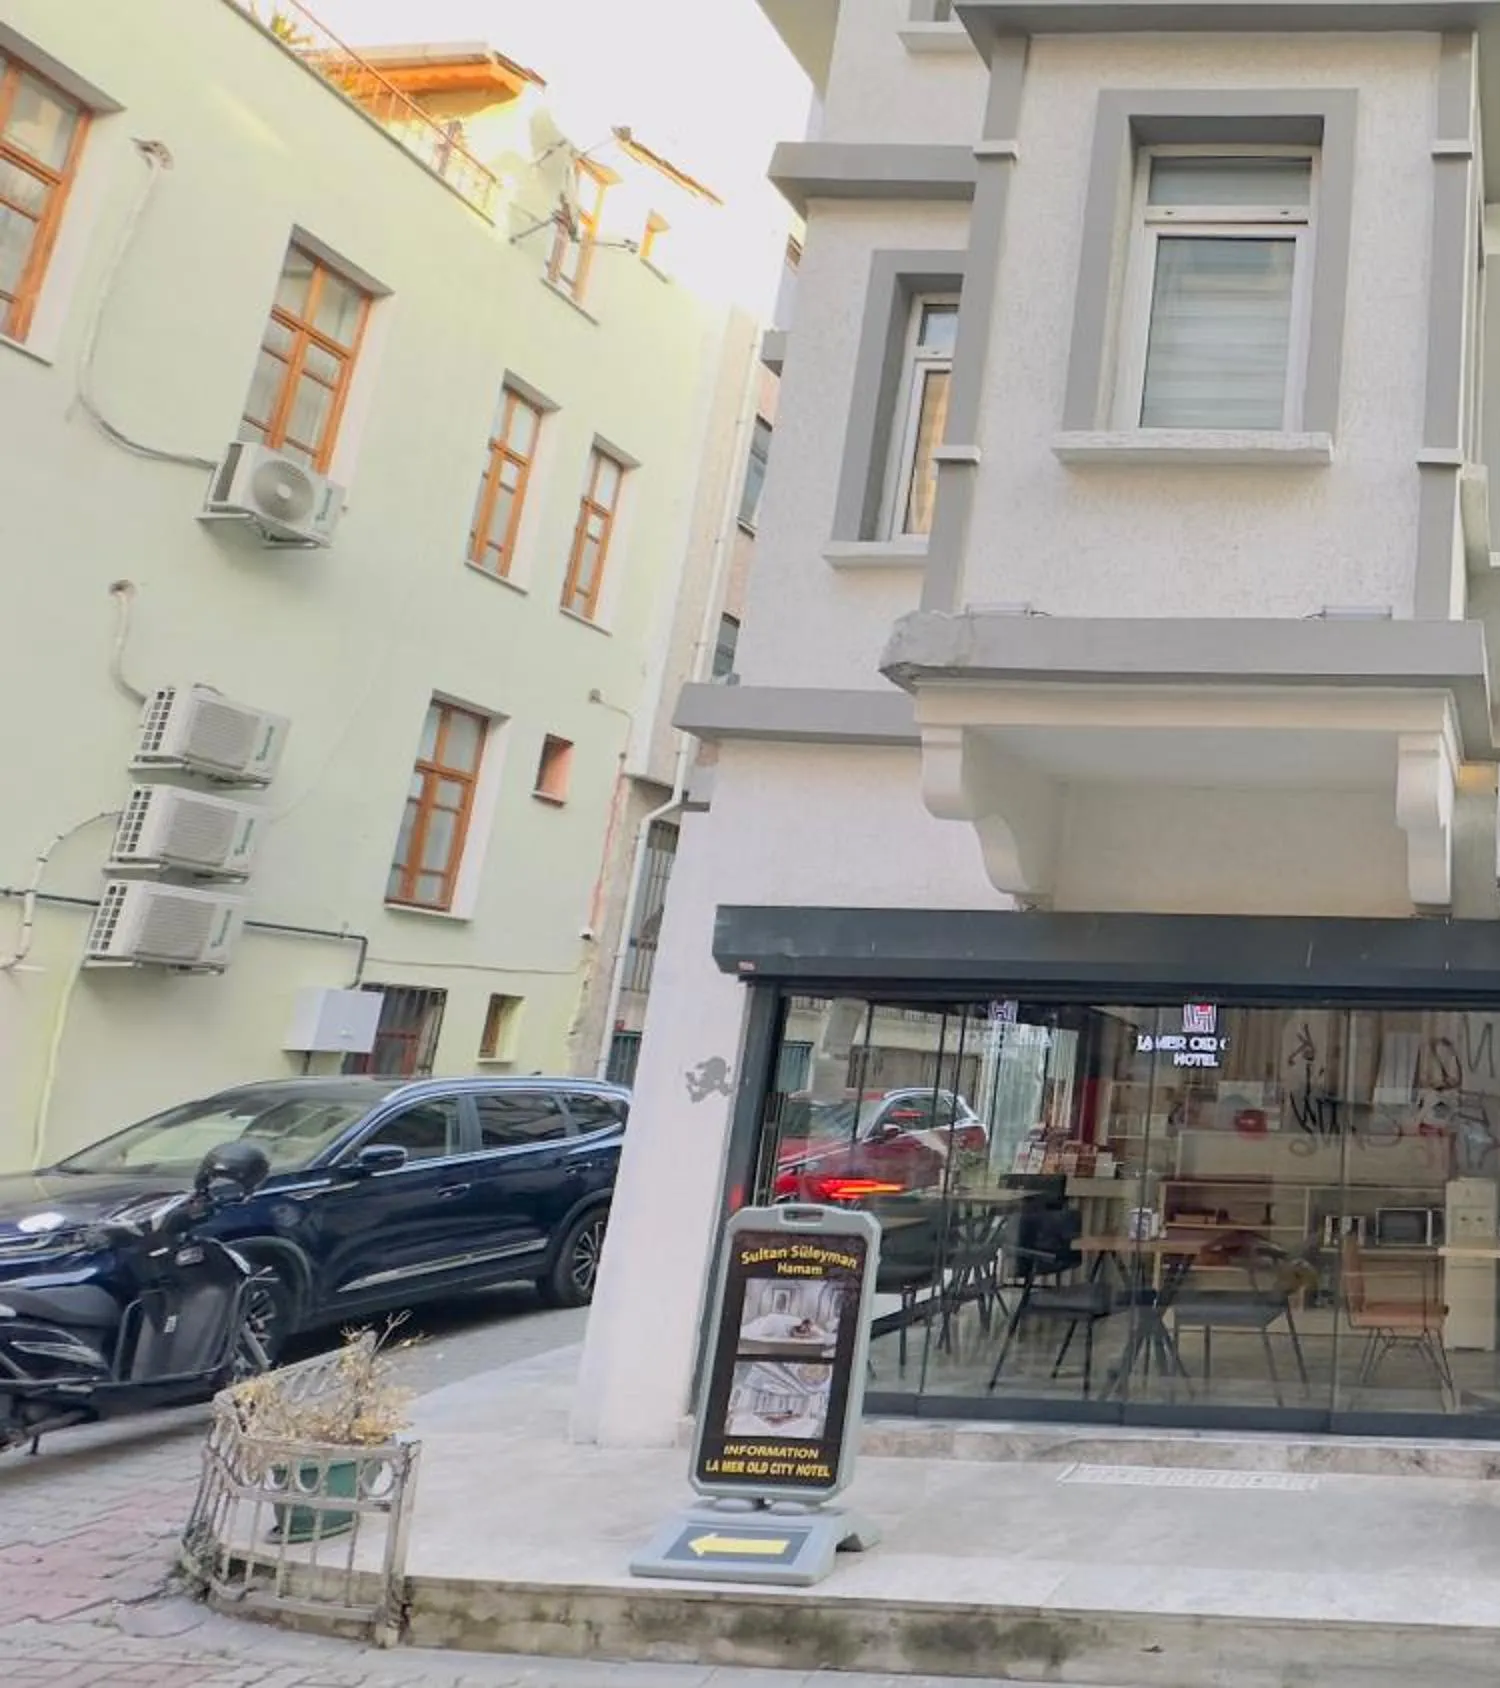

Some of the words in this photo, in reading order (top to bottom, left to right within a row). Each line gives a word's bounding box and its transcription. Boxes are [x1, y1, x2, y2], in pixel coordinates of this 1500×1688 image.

[1173, 1052, 1219, 1067] HOTEL
[741, 1247, 788, 1265] Sultan
[791, 1245, 857, 1269] Süleyman
[777, 1262, 823, 1275] Hamam
[724, 1445, 819, 1459] INFORMATION
[705, 1459, 719, 1472] LA
[722, 1460, 745, 1473] MER
[746, 1461, 769, 1474] OLD
[770, 1462, 796, 1475] CITY
[796, 1463, 830, 1478] HOTEL
